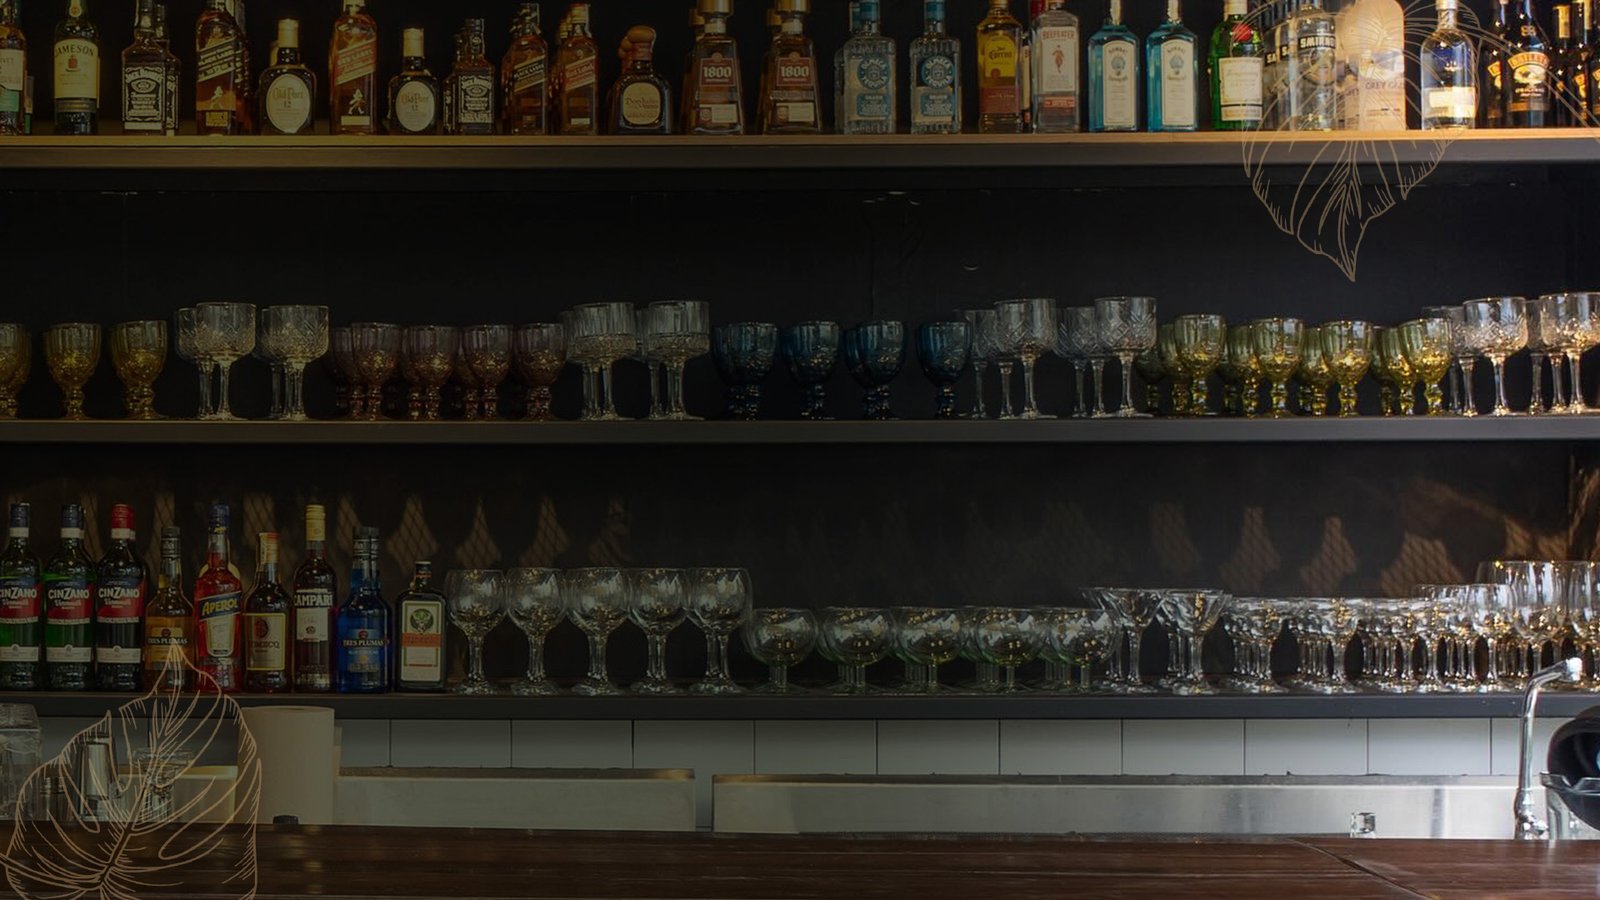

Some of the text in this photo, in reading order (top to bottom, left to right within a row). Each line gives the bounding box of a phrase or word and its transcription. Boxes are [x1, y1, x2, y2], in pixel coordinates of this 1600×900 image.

[1042, 30, 1075, 40] BEEFEATER
[55, 44, 94, 58] JAMESON
[704, 66, 732, 78] 1800
[781, 65, 809, 77] 1800
[48, 588, 90, 600] CINZANO
[98, 586, 140, 599] CINZANO
[202, 598, 238, 616] APEROL
[161, 637, 187, 645] PLUAS
